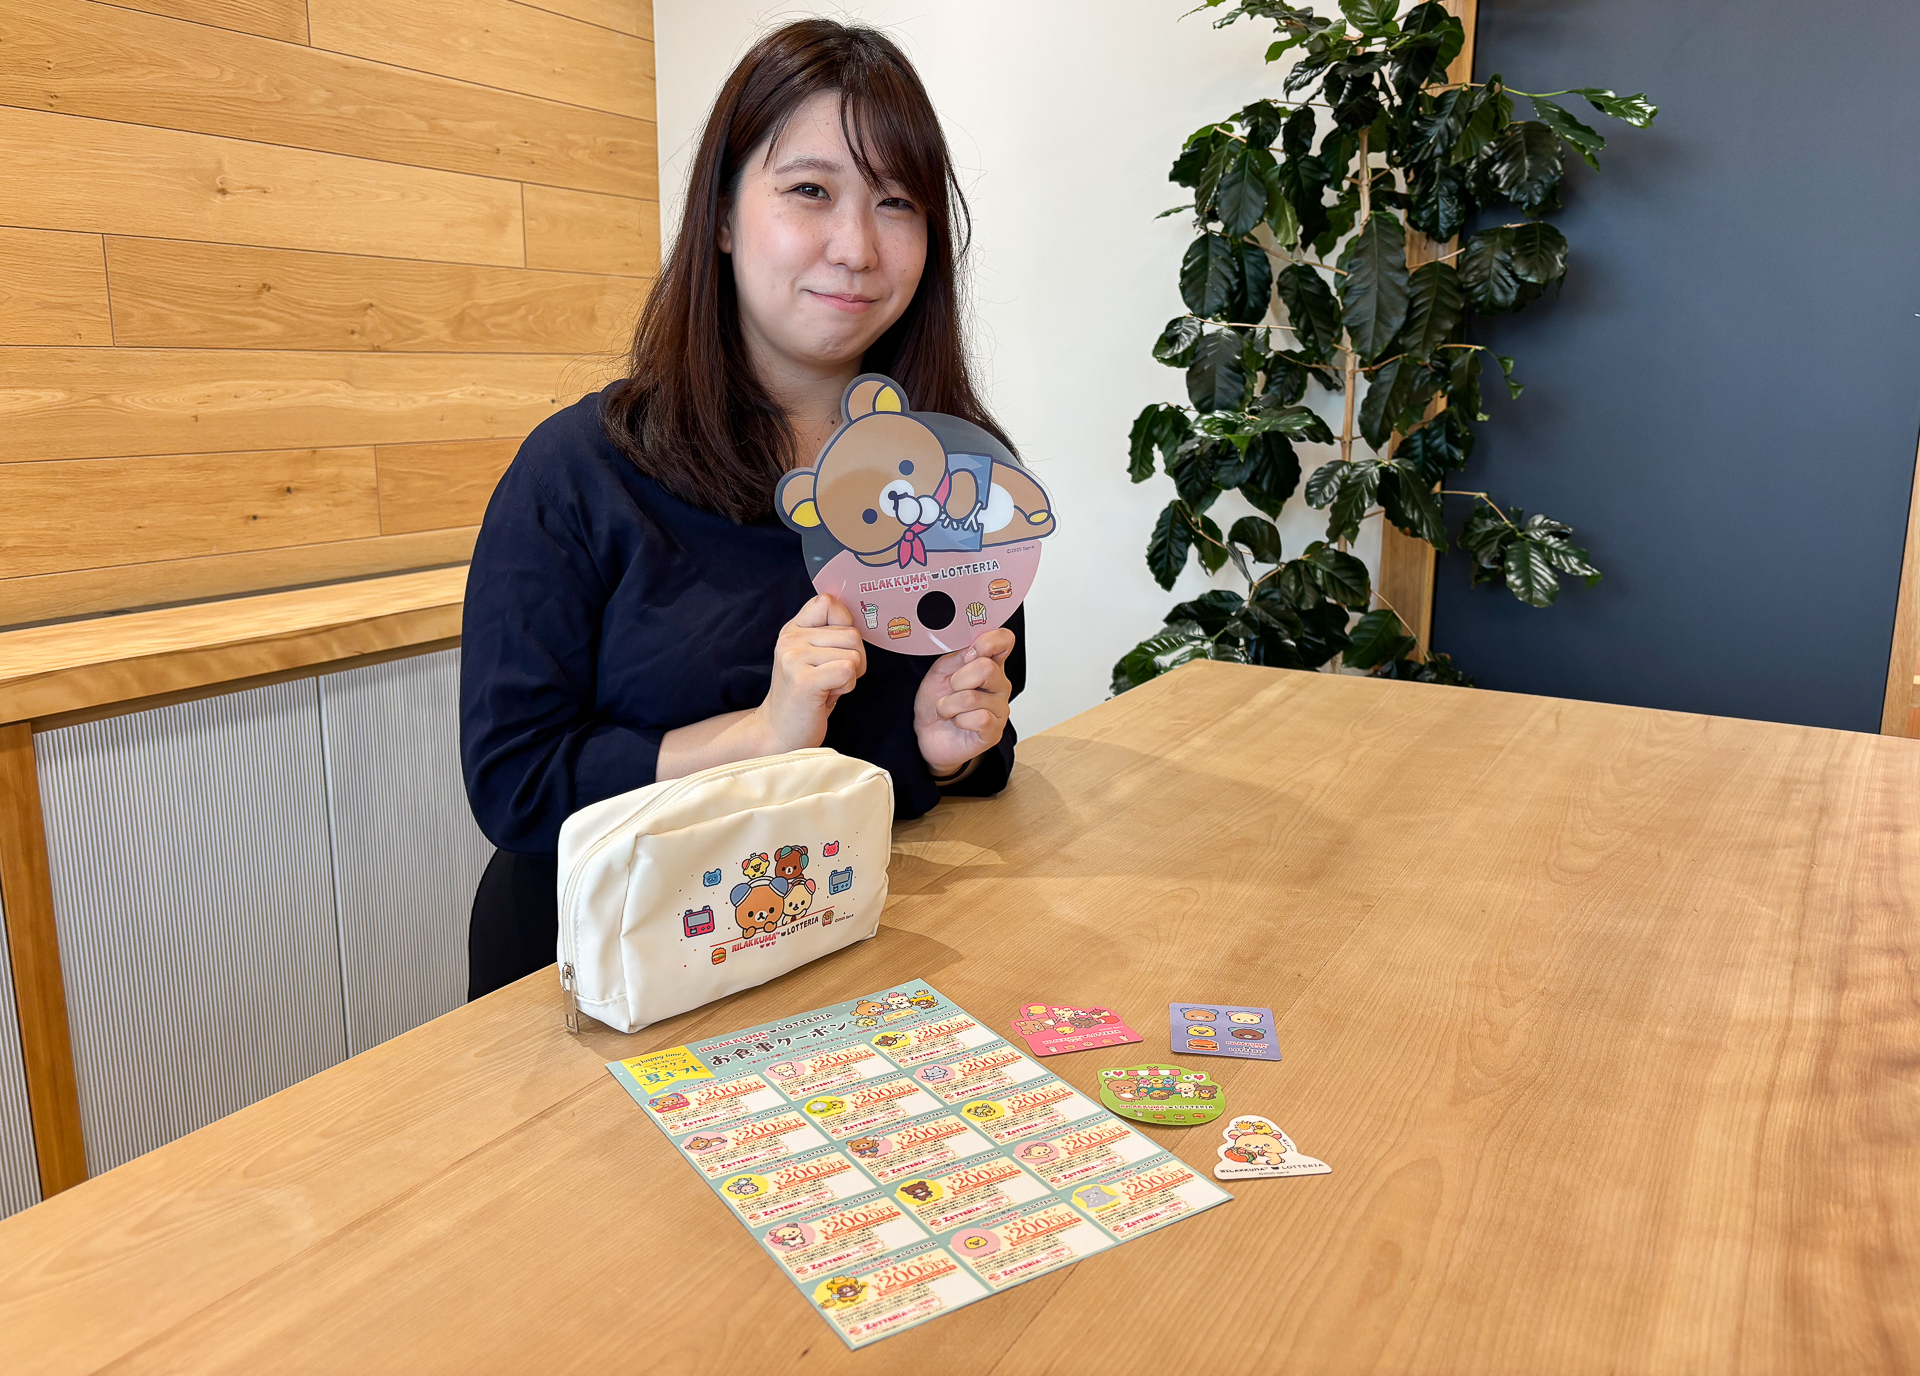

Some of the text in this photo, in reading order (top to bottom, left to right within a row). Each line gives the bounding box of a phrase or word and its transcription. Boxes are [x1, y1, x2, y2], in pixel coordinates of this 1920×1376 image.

[940, 560, 1000, 579] LOTTERIA
[786, 916, 819, 936] LOTTERIA
[777, 1013, 833, 1031] LOTTERIA
[709, 1022, 846, 1065] お食事クーポン
[638, 1064, 703, 1087] 夏ギフト
